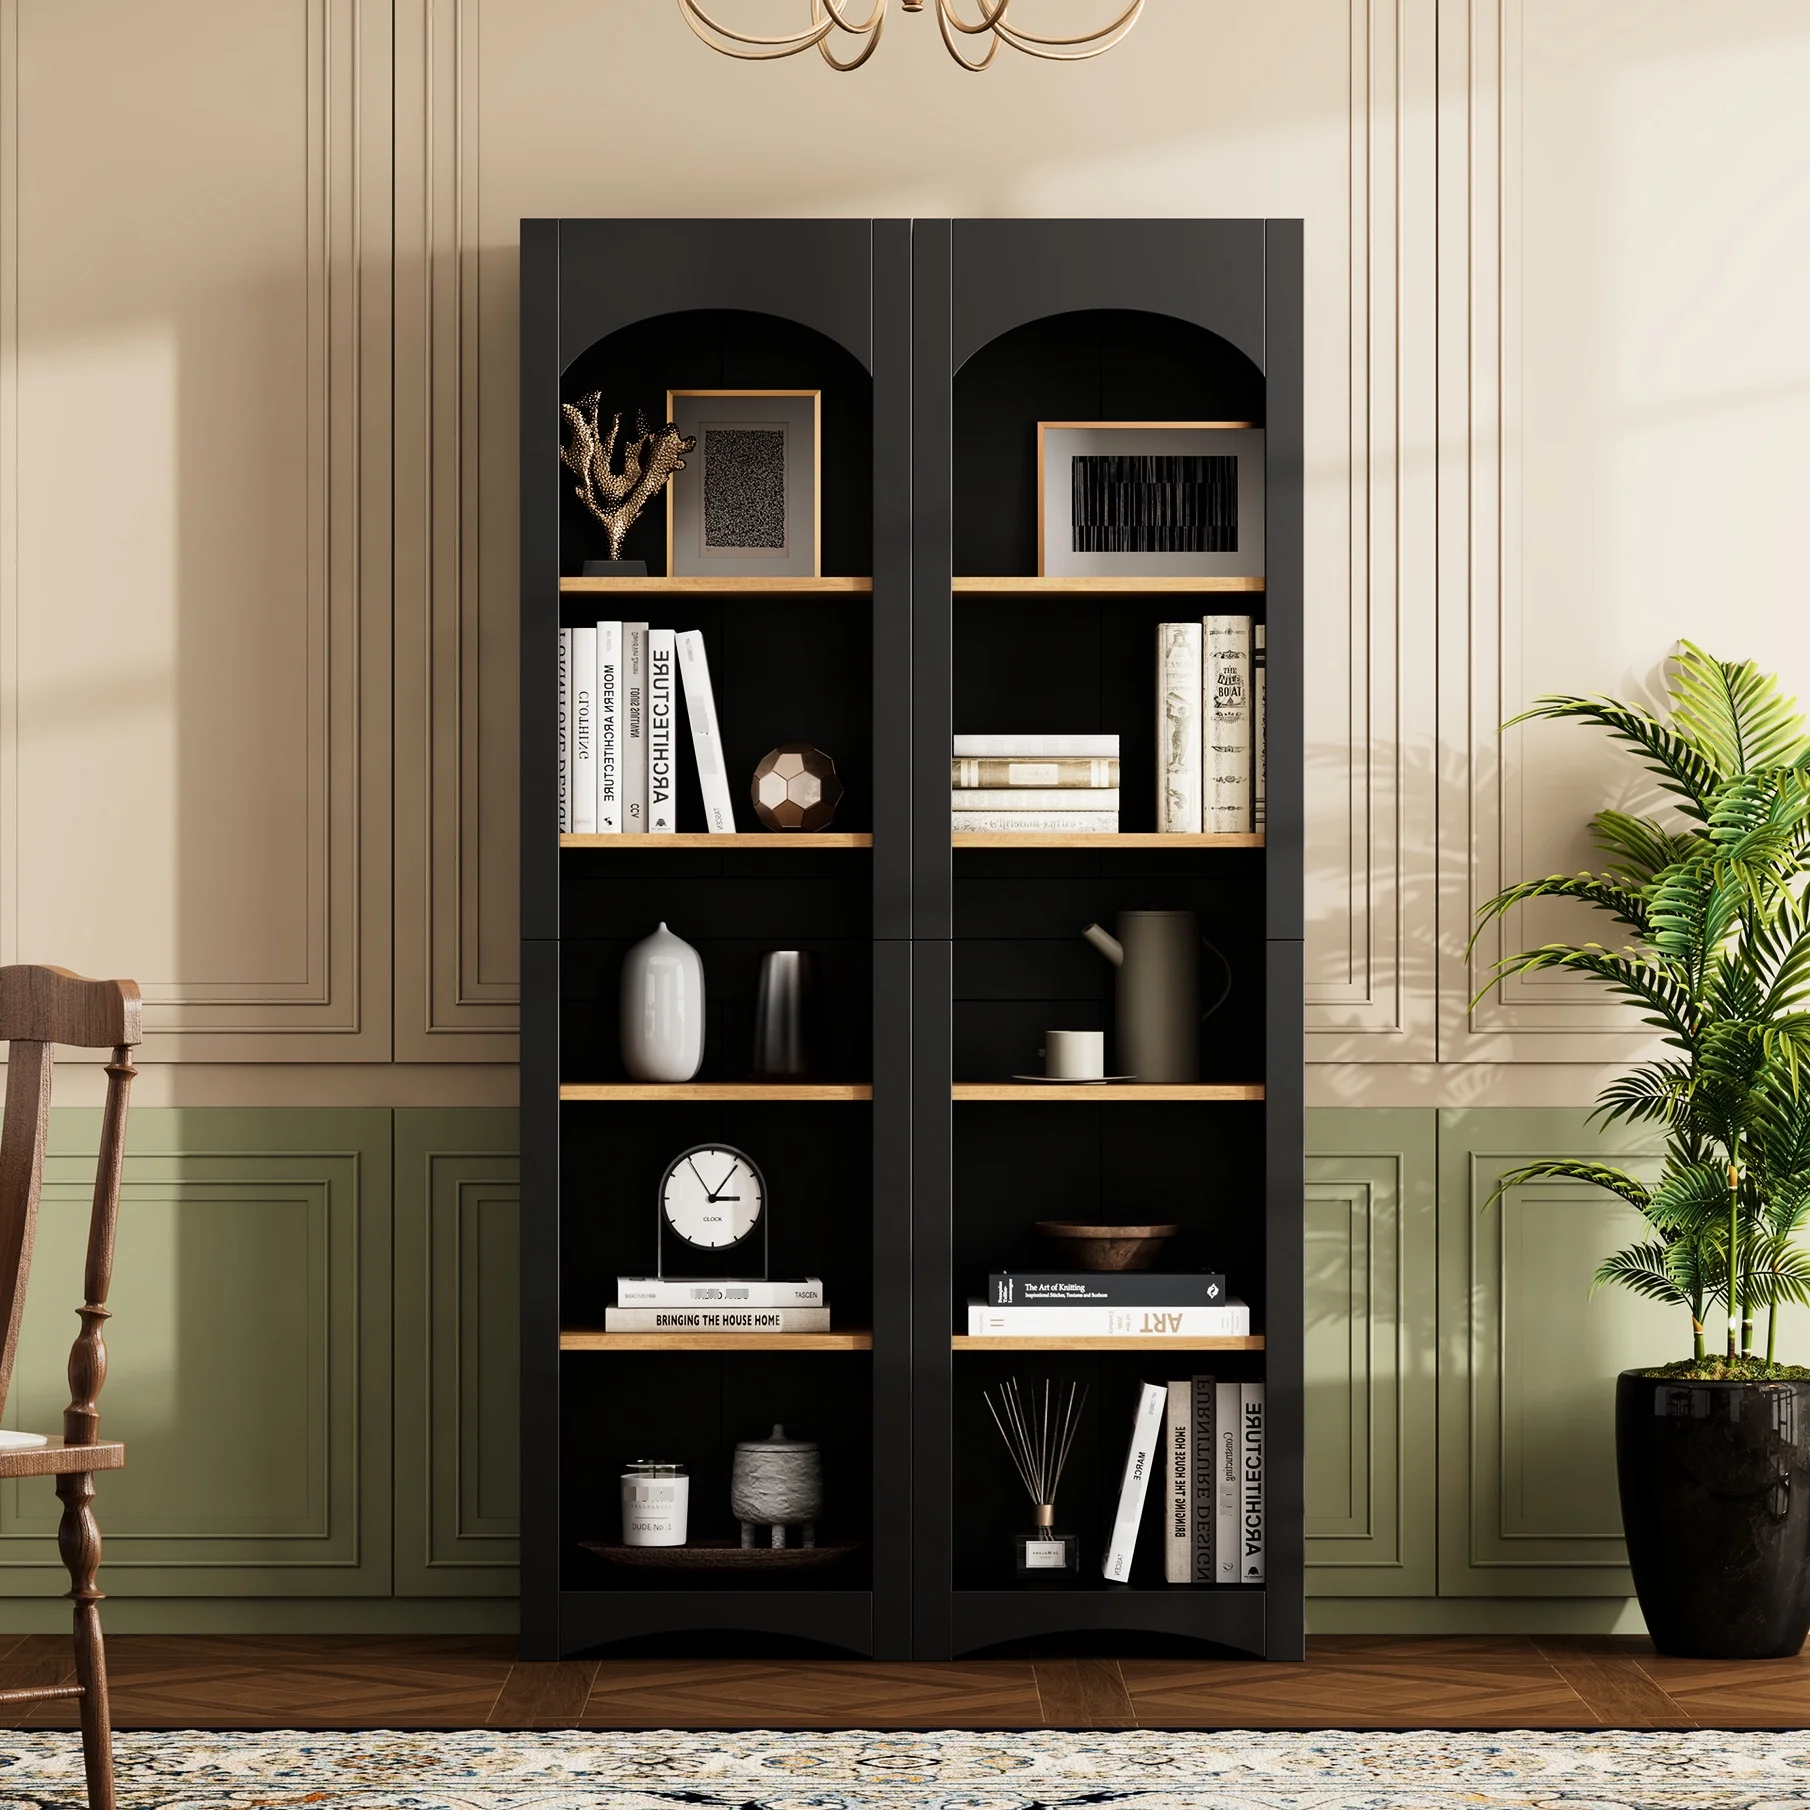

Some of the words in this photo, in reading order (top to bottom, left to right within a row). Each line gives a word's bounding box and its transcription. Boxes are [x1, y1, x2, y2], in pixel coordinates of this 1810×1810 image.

[1218, 686, 1242, 697] BOAT
[1058, 1284, 1086, 1293] Knitting
[656, 1314, 700, 1326] BRINGING
[702, 1314, 720, 1326] THE
[722, 1314, 752, 1326] HOUSE
[754, 1314, 780, 1326] HOME
[1140, 1312, 1184, 1333] ART
